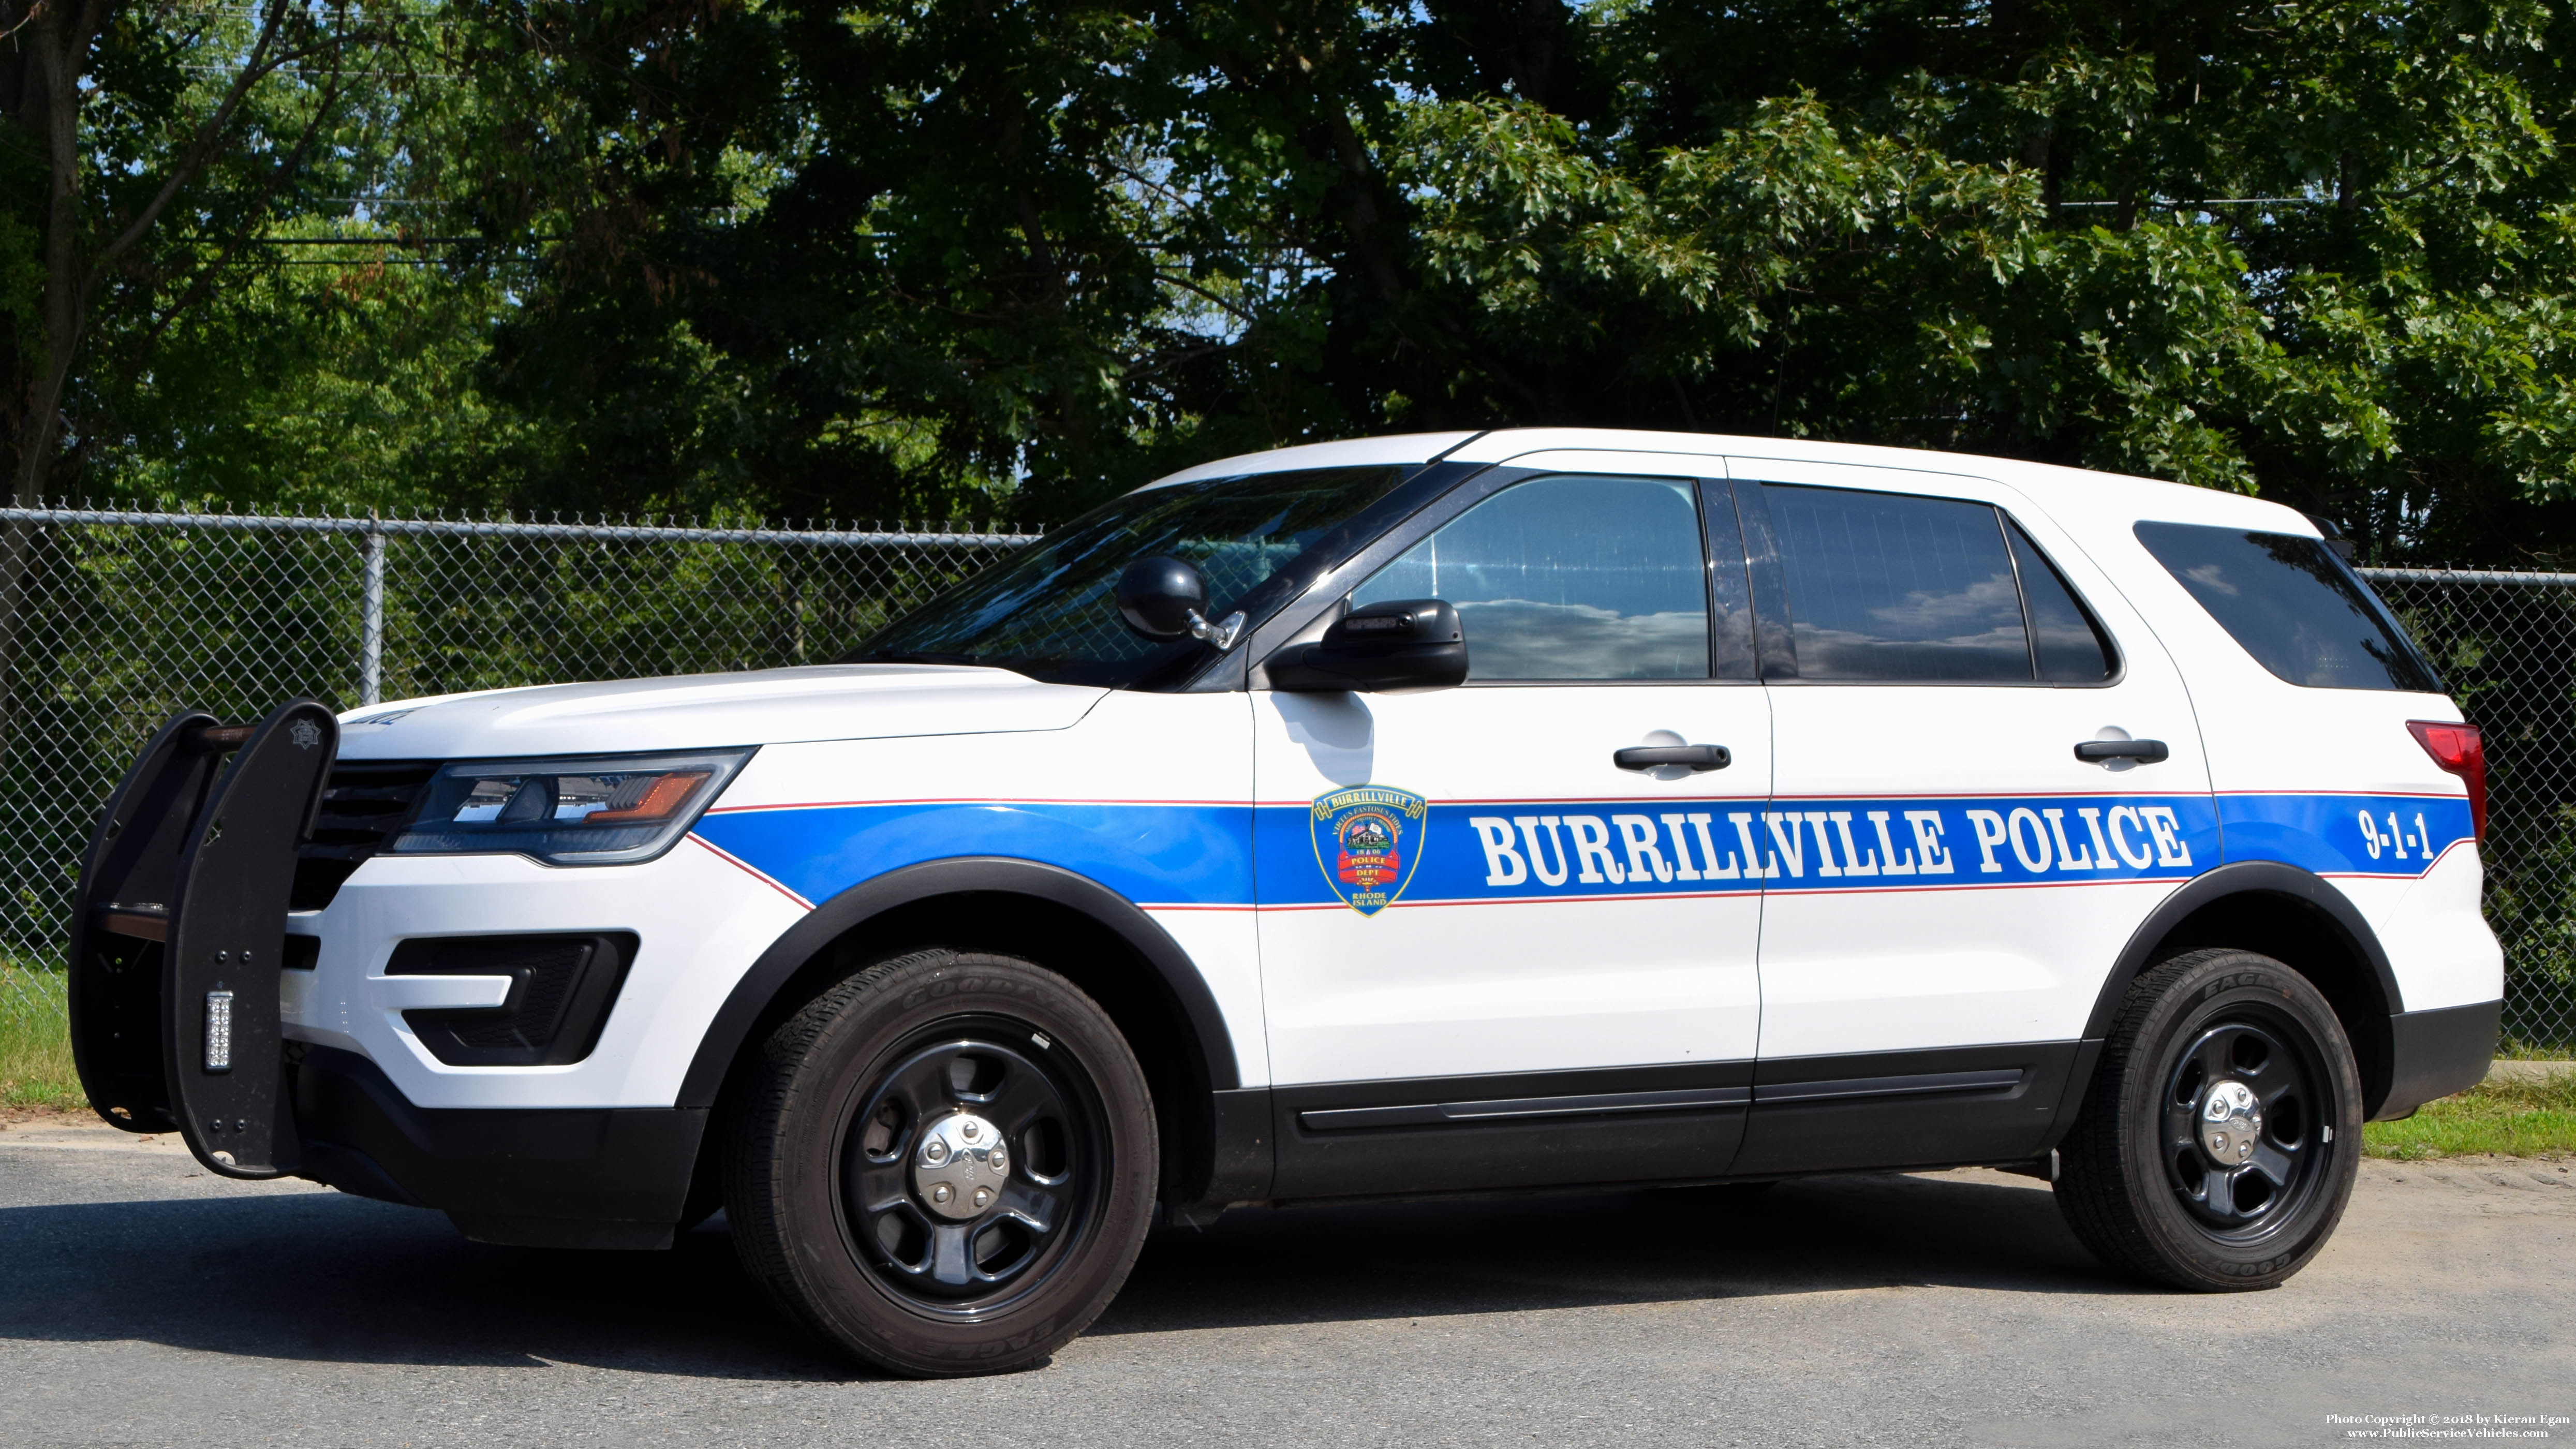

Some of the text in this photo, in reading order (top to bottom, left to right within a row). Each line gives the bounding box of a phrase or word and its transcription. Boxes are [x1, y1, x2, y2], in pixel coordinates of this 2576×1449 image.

[1331, 791, 1407, 807] BURRILLVILLE
[1469, 806, 2193, 886] BURRILLVILLE POLICE
[2358, 809, 2434, 860] 9-1-1
[1351, 856, 1385, 865] POLICE
[2204, 972, 2291, 1000] EAGLE
